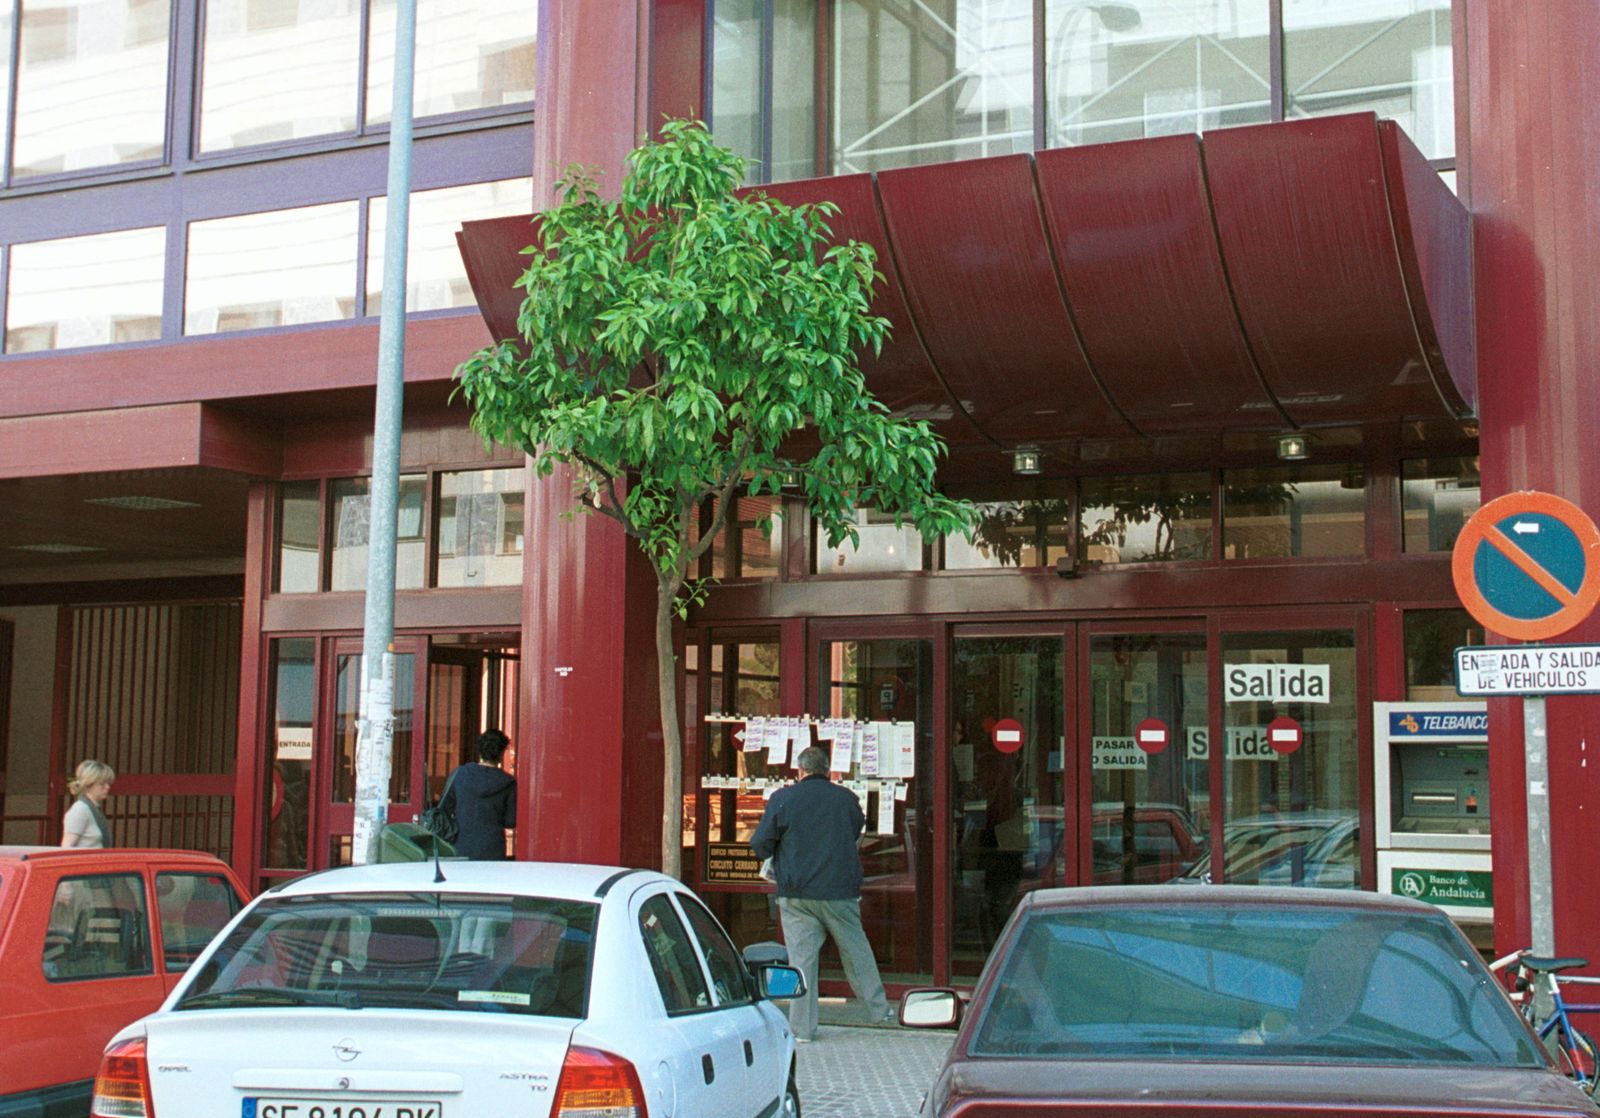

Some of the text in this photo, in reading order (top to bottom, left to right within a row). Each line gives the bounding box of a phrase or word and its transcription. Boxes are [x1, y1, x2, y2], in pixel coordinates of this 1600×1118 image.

[1462, 653, 1530, 671] ENADA
[1536, 652, 1543, 668] Y
[1229, 668, 1323, 697] Salida
[1504, 670, 1587, 689] VEHICULOS
[1423, 715, 1488, 730] TELEBANCO
[1095, 740, 1134, 750] PASAR
[1103, 755, 1146, 765] SALIDA
[1429, 874, 1469, 886] Banco de
[1429, 885, 1486, 899] Andalucía
